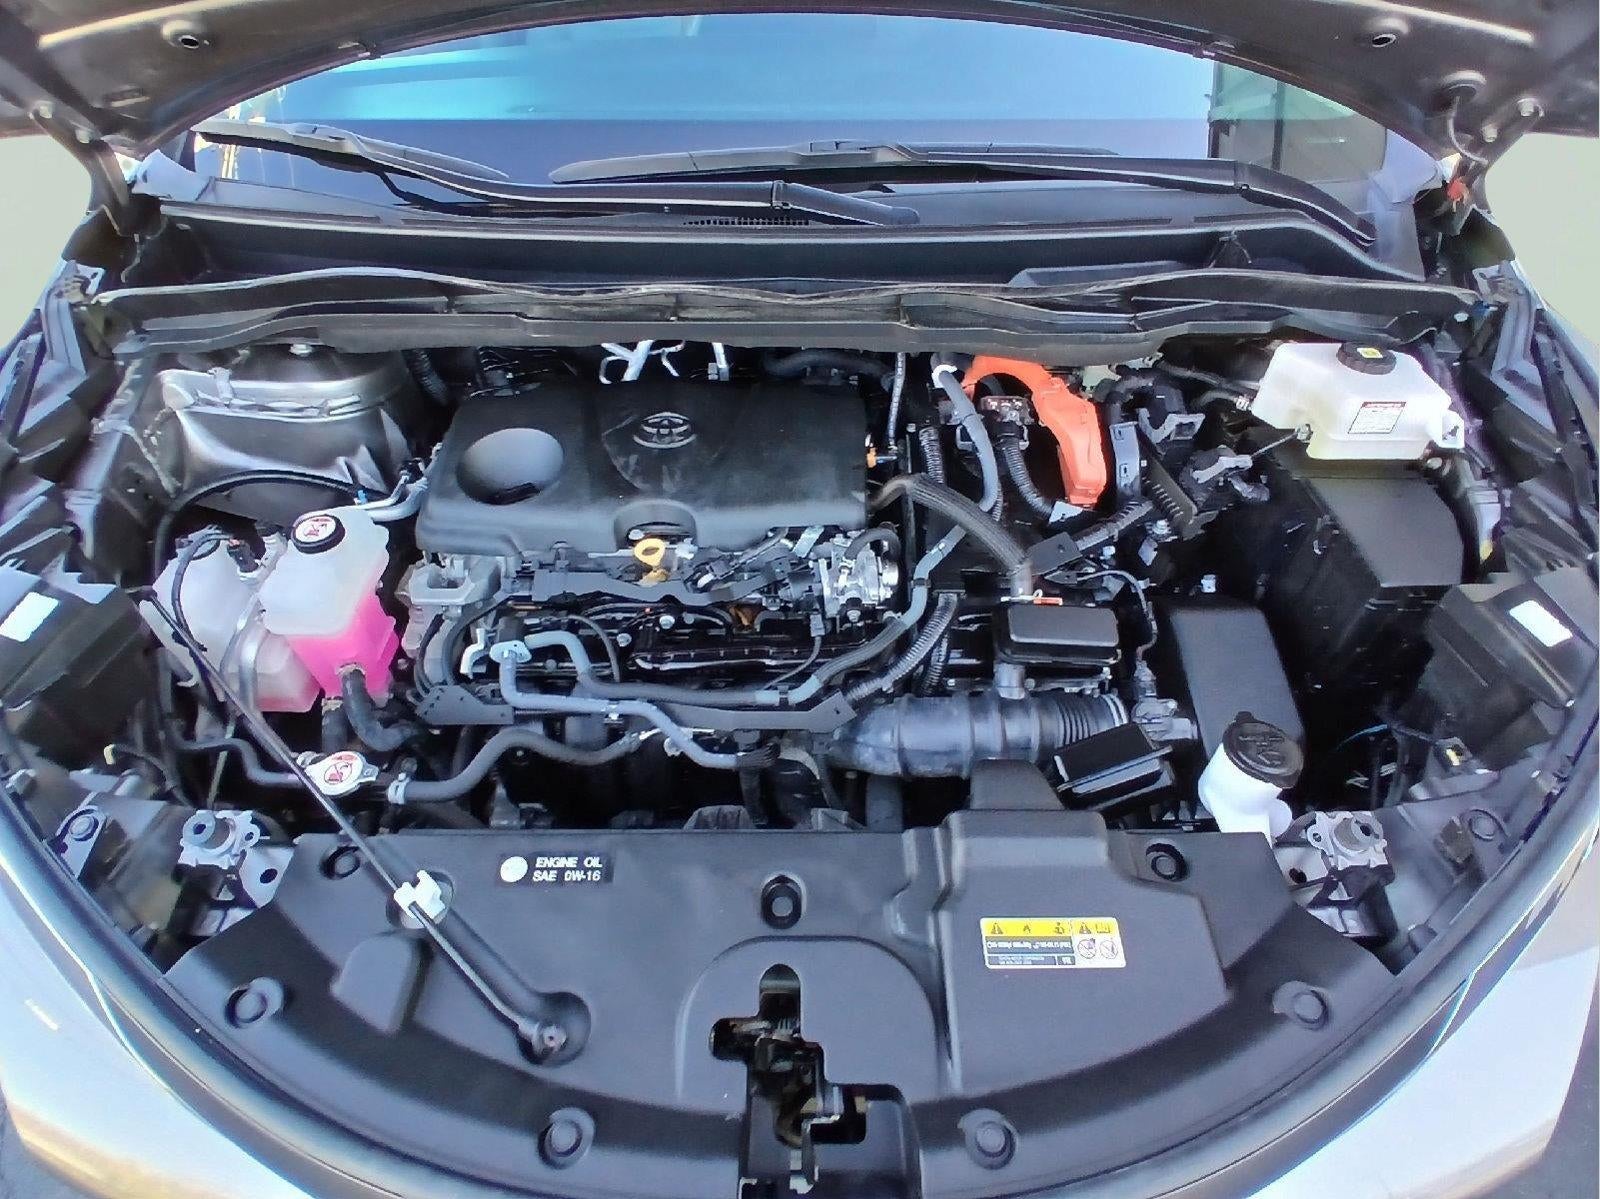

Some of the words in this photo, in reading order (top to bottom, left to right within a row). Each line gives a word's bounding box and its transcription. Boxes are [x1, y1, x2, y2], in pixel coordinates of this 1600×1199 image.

[535, 856, 578, 868] ENGINE
[583, 856, 603, 868] OIL
[532, 869, 557, 882] SAE
[564, 869, 601, 882] 0W-16
